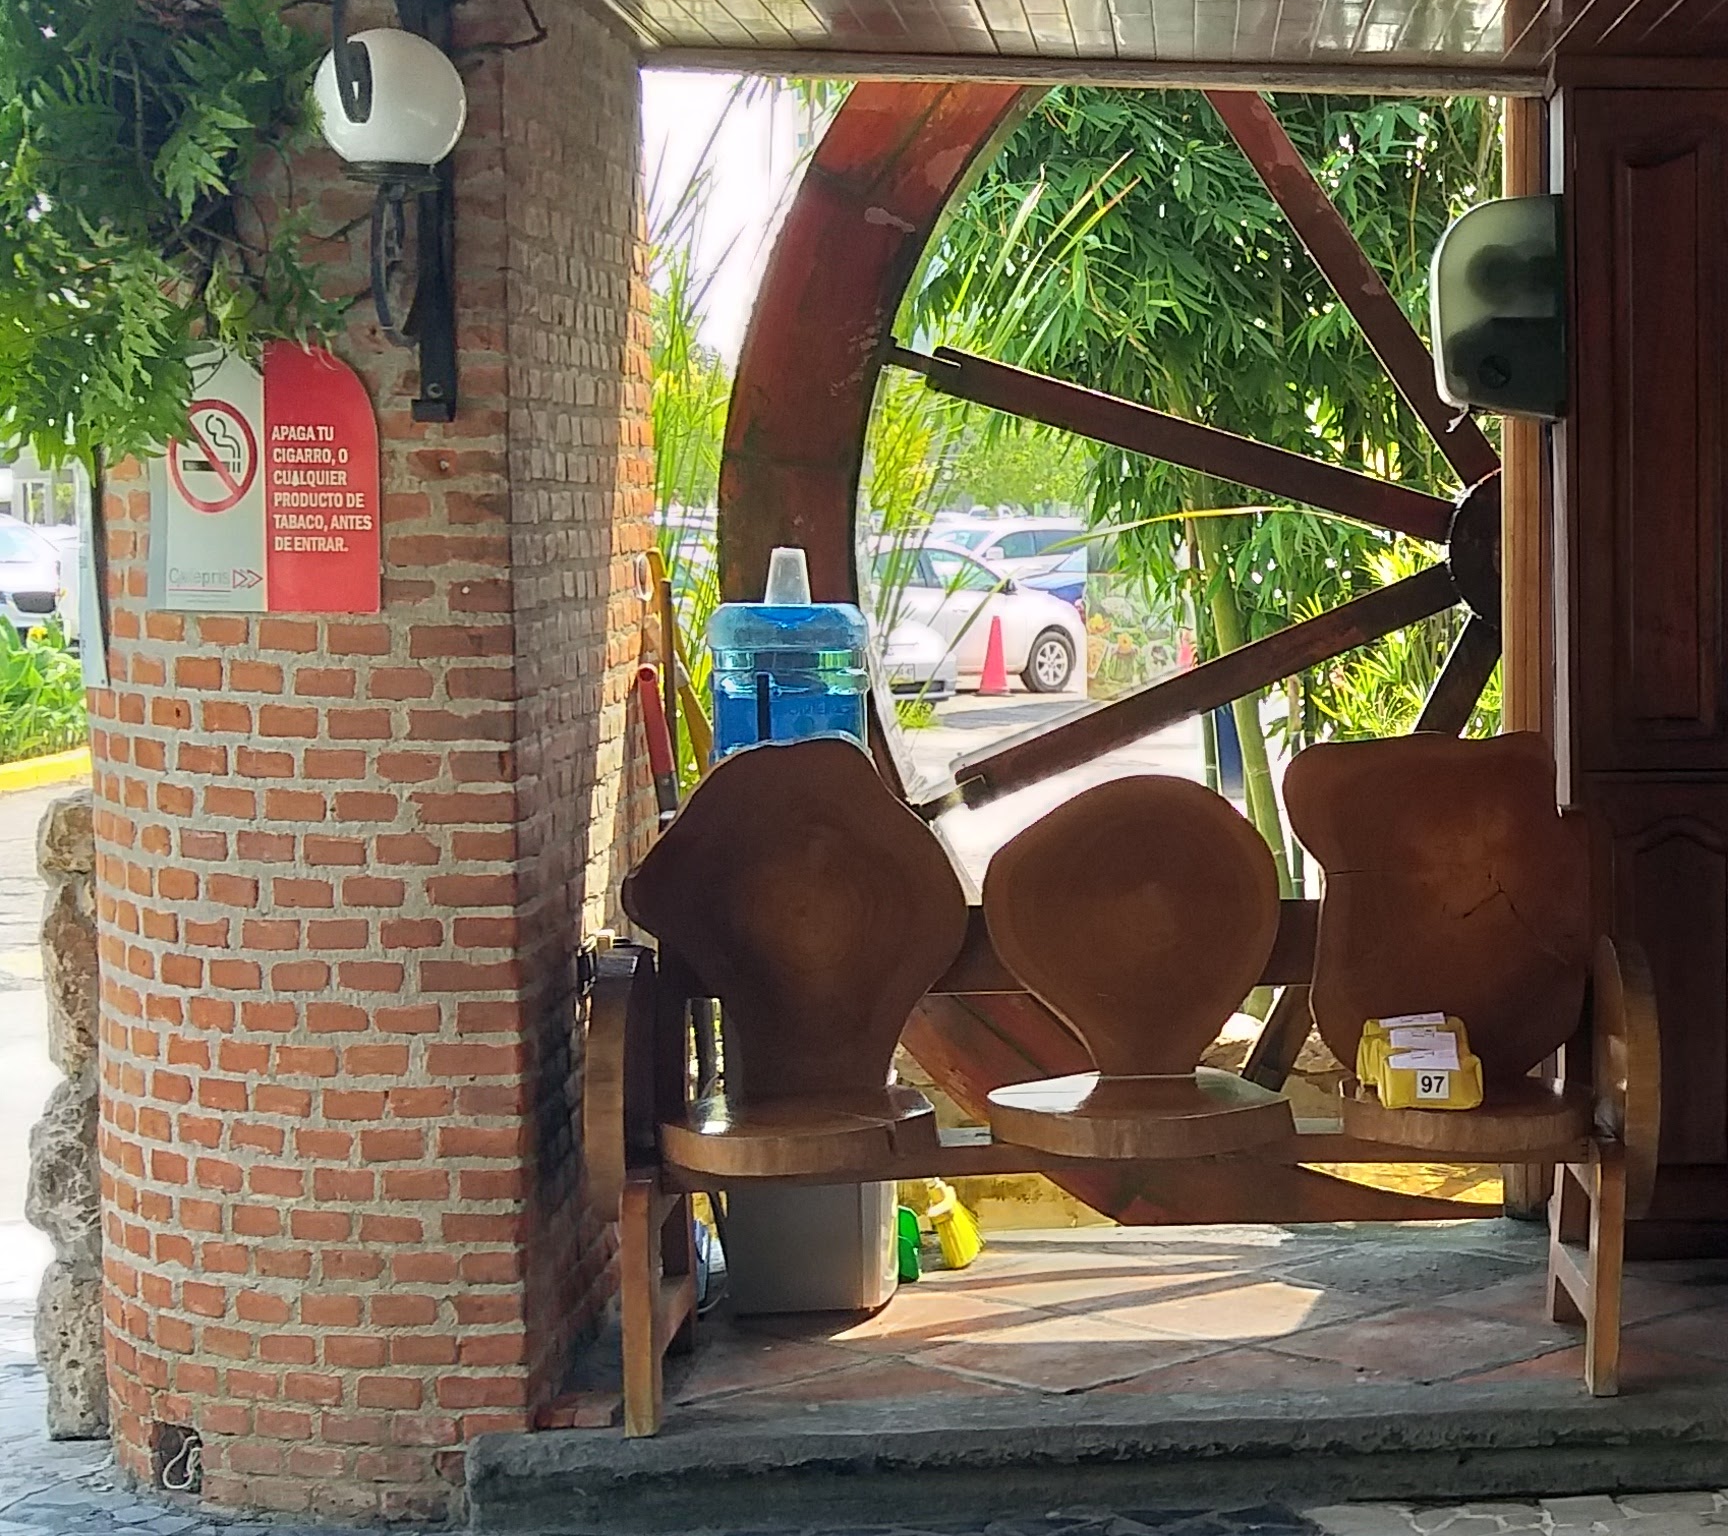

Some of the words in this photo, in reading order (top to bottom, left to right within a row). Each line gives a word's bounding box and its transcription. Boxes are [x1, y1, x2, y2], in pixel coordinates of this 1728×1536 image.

[271, 425, 316, 441] APAGA
[316, 426, 335, 442] TU
[273, 447, 336, 466] CIGARRO,
[338, 448, 349, 464] O
[273, 469, 347, 487] CUALQUIER
[273, 492, 343, 508] PRODUCTO
[345, 493, 365, 508] DE
[272, 514, 328, 532] TABACO,
[330, 515, 373, 530] ANTES
[274, 536, 293, 552] DE
[294, 536, 349, 552] ENTRAR.
[1421, 1075, 1445, 1093] 97
